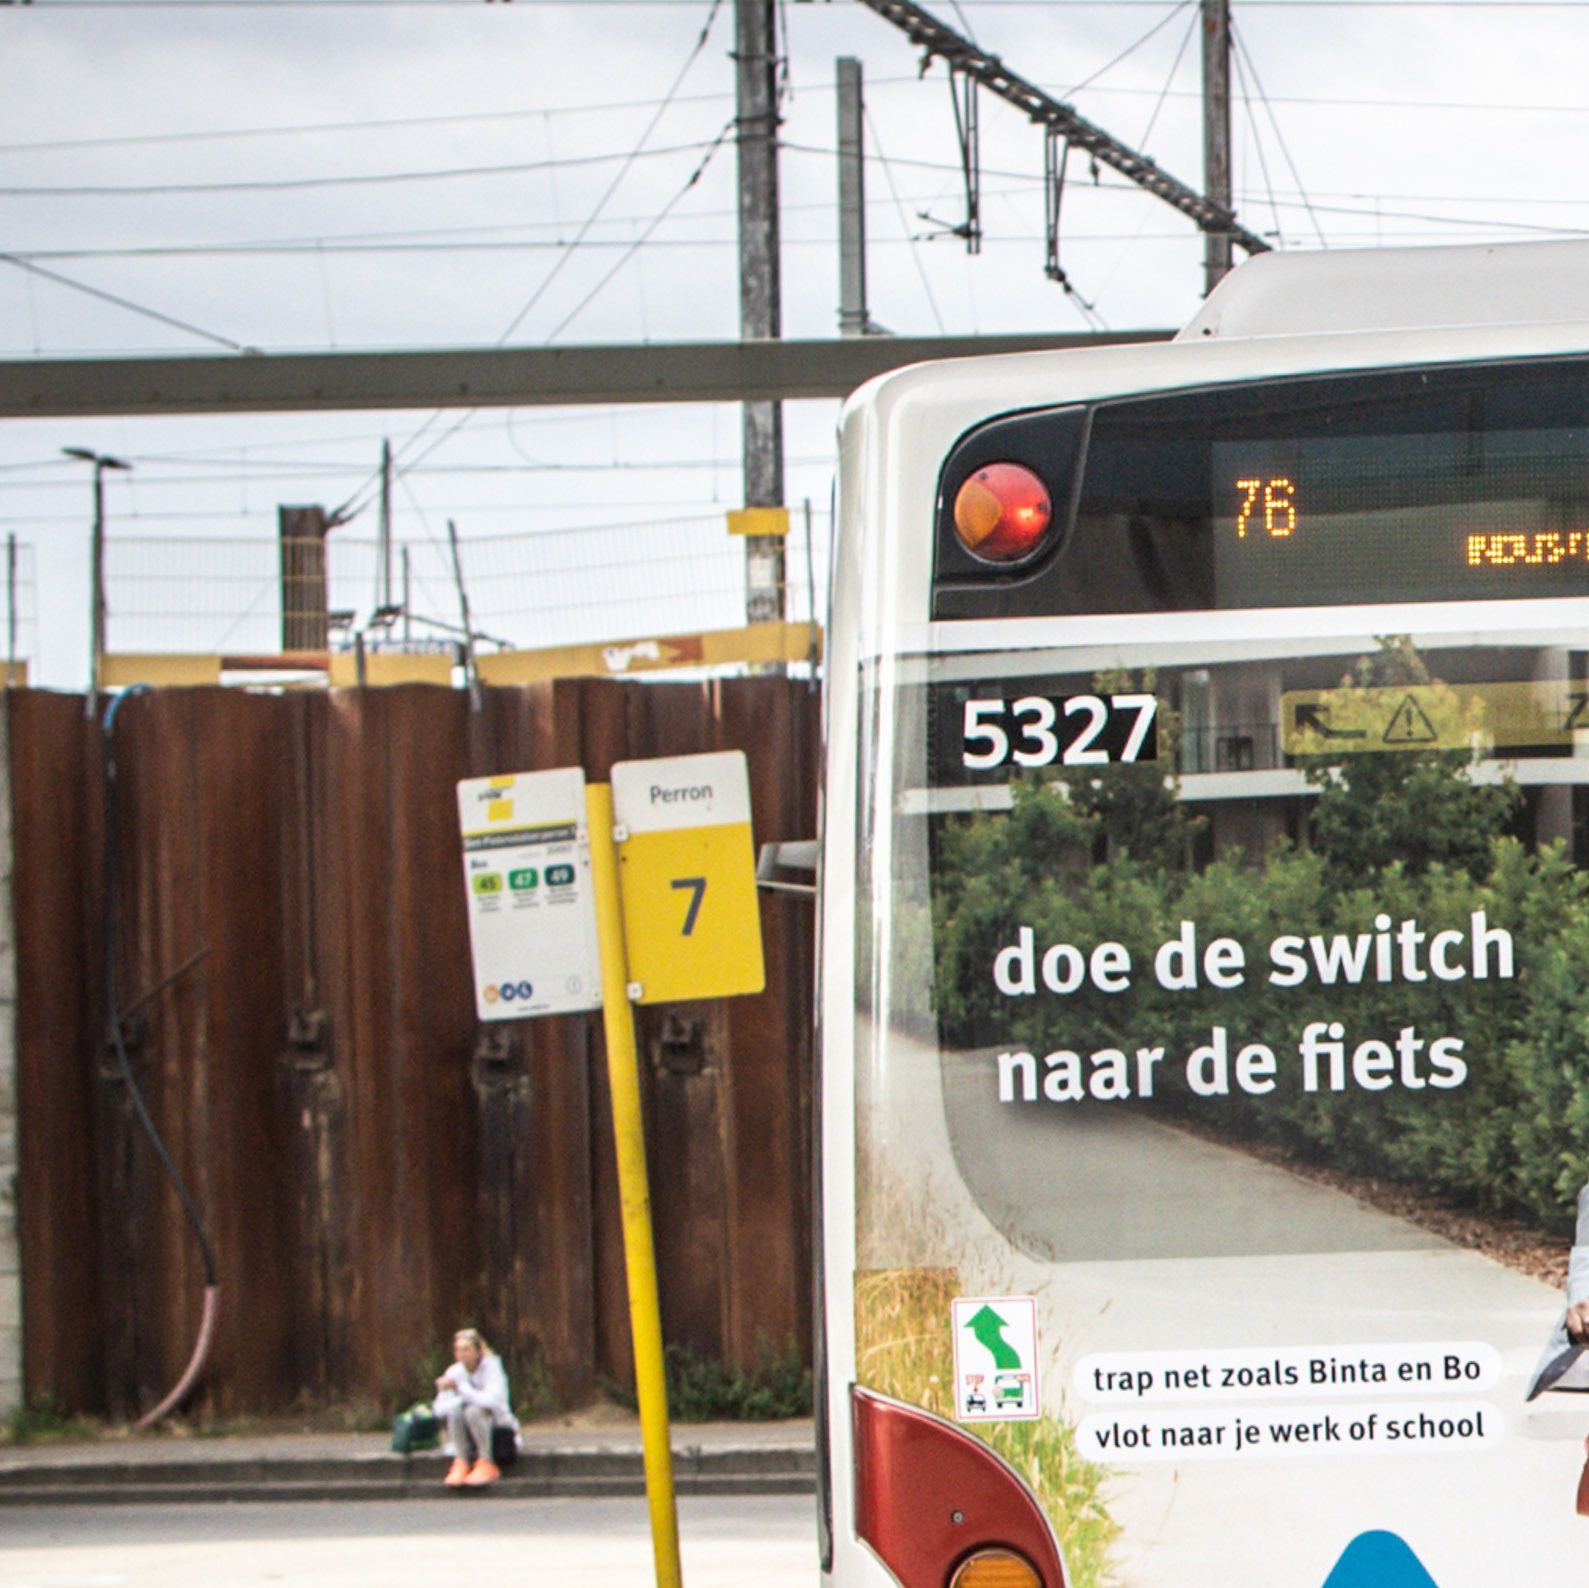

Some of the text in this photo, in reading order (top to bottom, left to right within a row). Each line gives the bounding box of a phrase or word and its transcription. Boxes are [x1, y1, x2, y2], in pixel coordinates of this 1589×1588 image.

[1236, 479, 1296, 538] 76
[963, 693, 1158, 769] 5327
[649, 784, 713, 804] Perron
[515, 873, 532, 887] 47
[670, 876, 707, 937] 7
[993, 911, 1514, 995] doe de switch
[997, 1022, 1469, 1101] naar de fiets
[1093, 1355, 1482, 1396] trap net zoals Binta en Bo
[1096, 1409, 1486, 1451] vlot naar je werk of school
